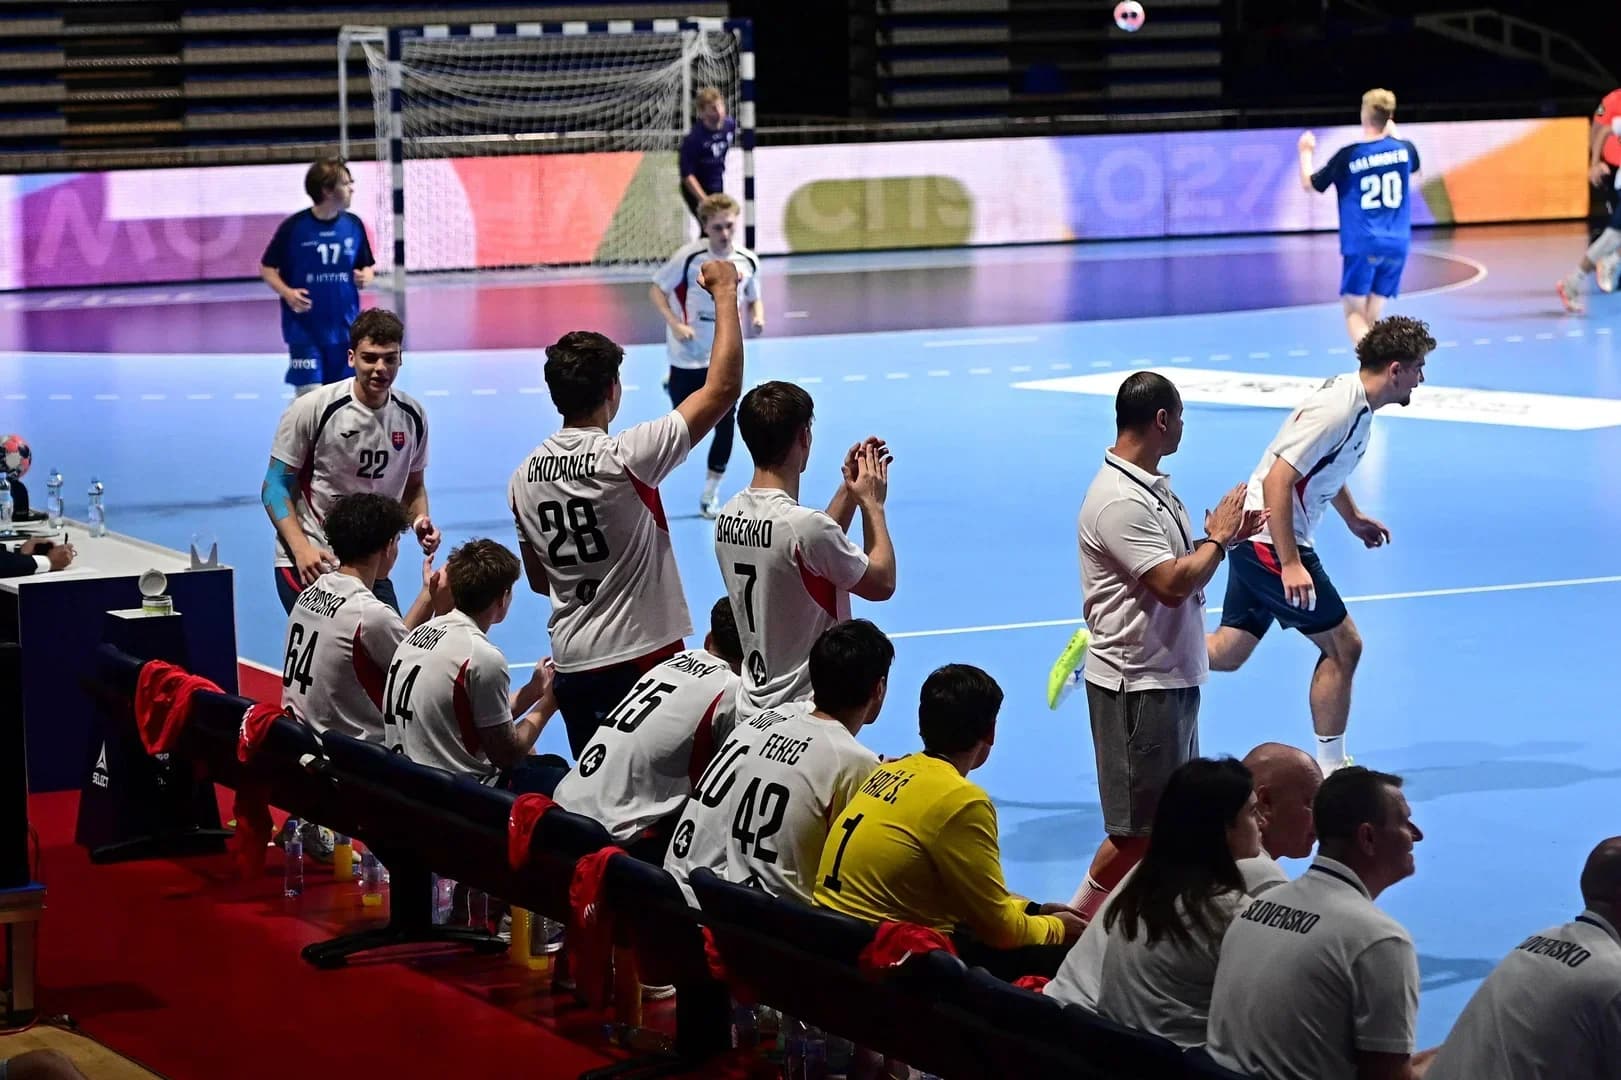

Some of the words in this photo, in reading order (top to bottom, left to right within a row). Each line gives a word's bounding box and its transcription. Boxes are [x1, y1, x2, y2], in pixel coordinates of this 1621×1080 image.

[1360, 169, 1403, 210] 20
[316, 242, 341, 265] 17
[356, 449, 389, 480] 22
[537, 498, 610, 567] 28
[715, 510, 773, 549] BAČENKO
[733, 562, 757, 633] 7
[282, 622, 319, 695] 64
[406, 625, 448, 651] KUBÍK
[384, 658, 422, 729] 14
[599, 678, 678, 733] 15
[690, 738, 751, 809] 16
[759, 733, 813, 766] FEKEČ
[92, 771, 109, 789] SELECT
[732, 777, 790, 864] 42
[823, 813, 865, 893] 1
[1240, 899, 1321, 935] SLOVENSKO
